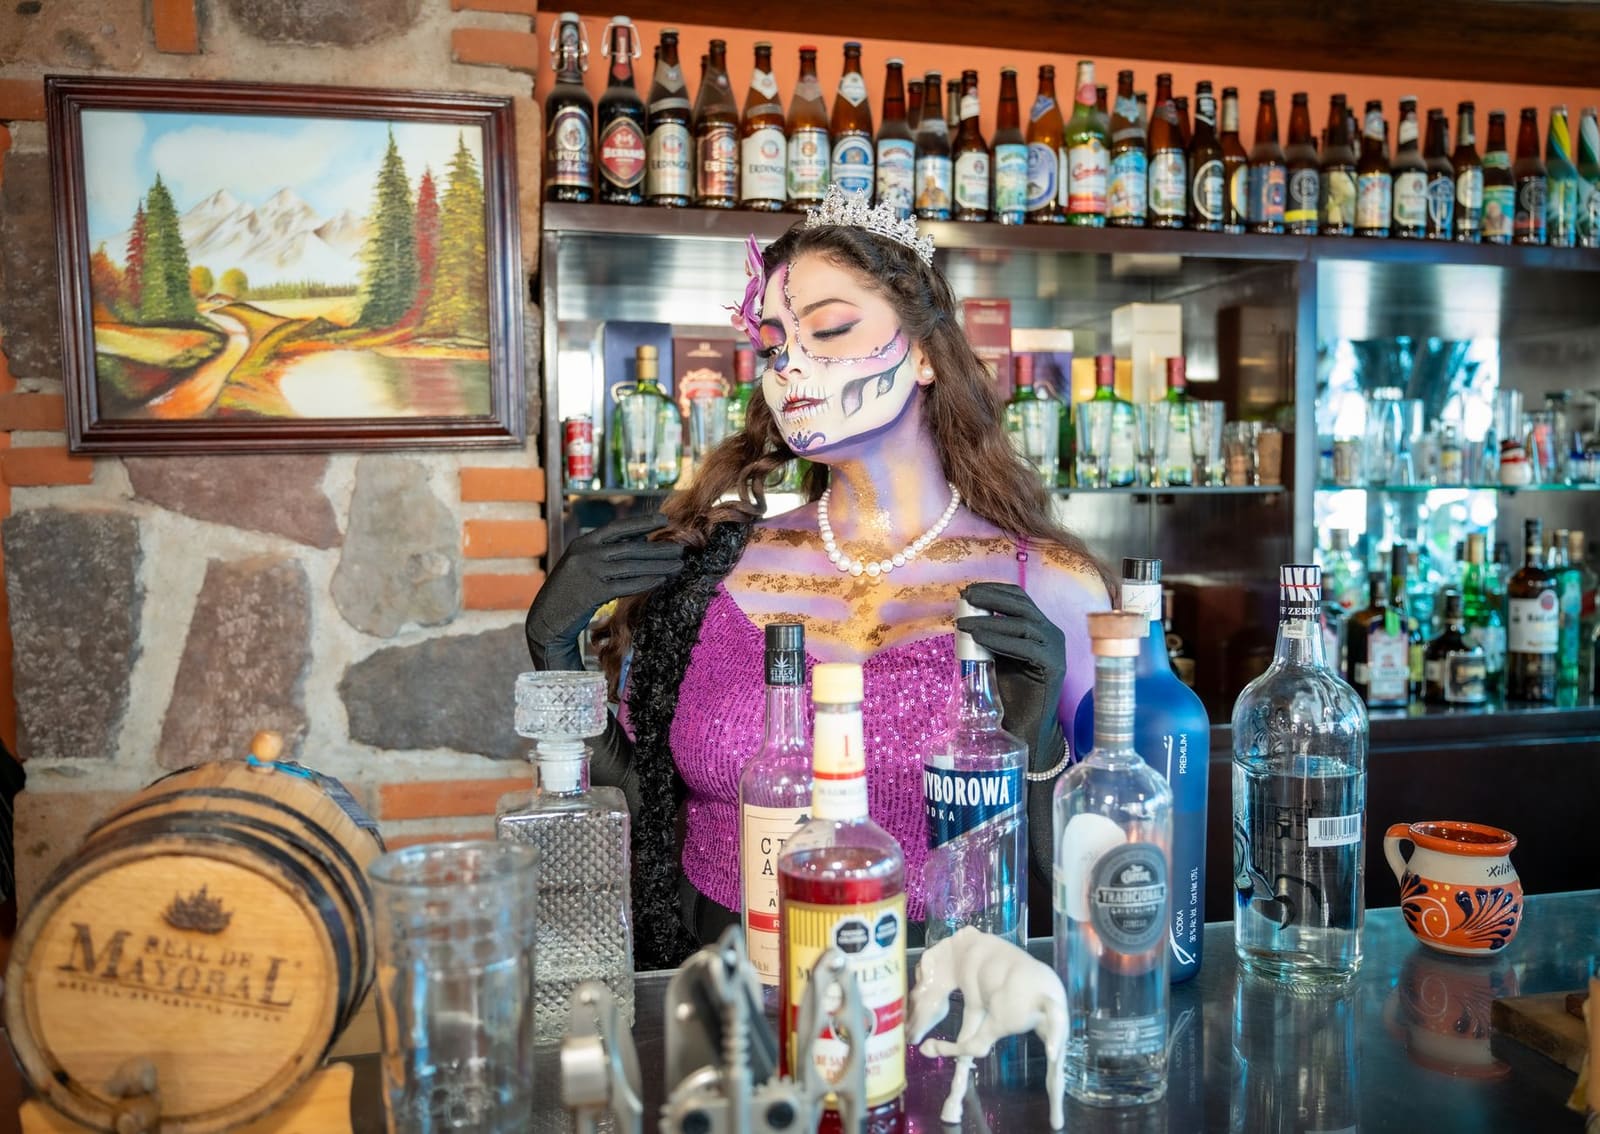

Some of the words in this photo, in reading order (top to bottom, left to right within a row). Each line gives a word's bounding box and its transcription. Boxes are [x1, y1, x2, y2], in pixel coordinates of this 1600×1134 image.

[1179, 733, 1187, 774] PREMIUM
[1175, 909, 1184, 938] VODKA
[57, 922, 297, 1007] MAYORAL
